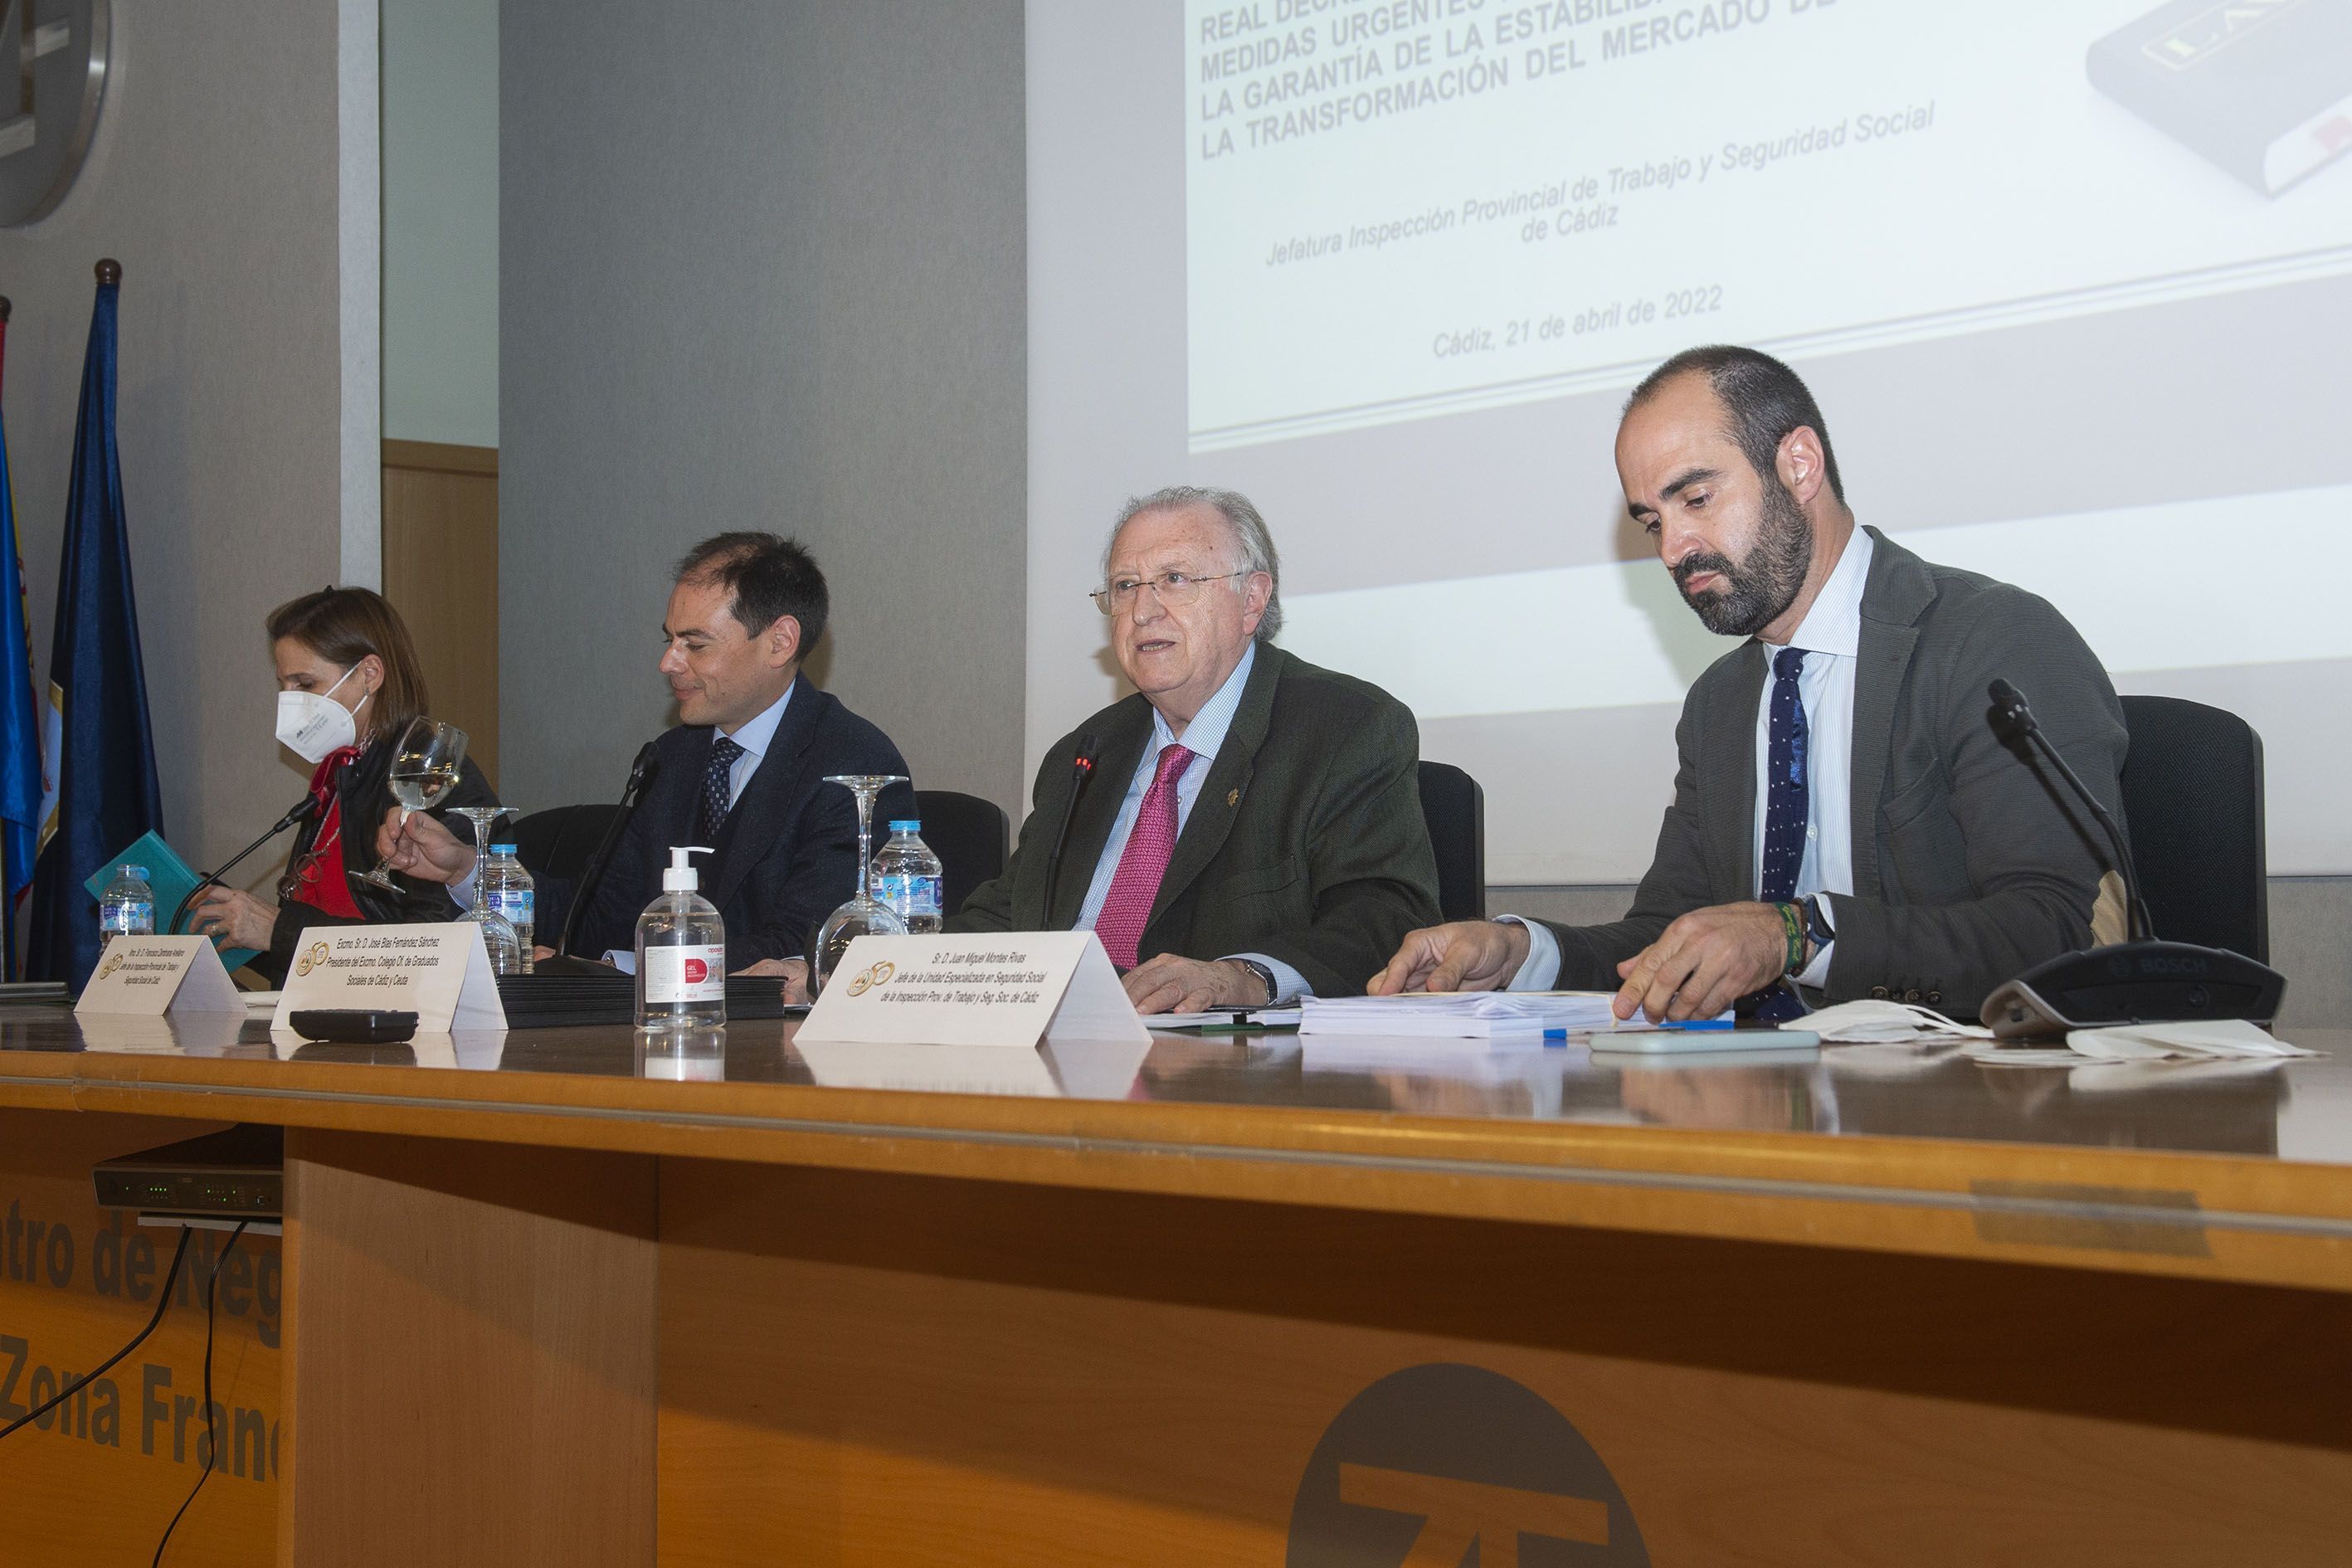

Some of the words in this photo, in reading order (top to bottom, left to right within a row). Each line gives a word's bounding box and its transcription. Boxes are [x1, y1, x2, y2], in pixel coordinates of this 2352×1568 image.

[1201, 1, 1268, 45] REAL
[1200, 26, 1317, 83] MEDIDAS
[1201, 88, 1235, 121] LA
[1244, 46, 1384, 110] GARANTÍA
[1395, 34, 1433, 71] DE
[1446, 22, 1484, 58] LA
[1201, 128, 1235, 160] LA
[1245, 56, 1509, 149] TRANSFORMACIÓN
[1526, 41, 1586, 80] DEL
[1602, 0, 1770, 61] MERCADO
[1266, 227, 1342, 267] Jefatura
[1349, 204, 1455, 251] Inspección
[1463, 178, 1566, 226] Provincial
[1571, 175, 1599, 202] de
[1607, 153, 1692, 195] Trabajo
[1697, 153, 1712, 183] y
[1721, 119, 1848, 171] Seguridad
[1854, 100, 1935, 144] Social
[1521, 216, 1548, 244] de
[1556, 202, 1619, 238] Cádiz
[1433, 327, 1497, 360] Cádiz,
[1506, 317, 1531, 345] 21
[1539, 309, 1565, 340] de
[1571, 299, 1620, 335] abril
[1627, 295, 1656, 326] de
[1663, 284, 1724, 318] 2022
[326, 957, 352, 967] Presidente
[351, 956, 361, 967] del
[377, 956, 397, 969] Colegio
[404, 955, 412, 967] de
[411, 955, 440, 967] Graduados
[368, 937, 382, 948] José
[381, 937, 392, 948] Blas
[392, 937, 418, 948] Fernández
[418, 936, 440, 947] Sánchez
[949, 952, 966, 963] Juan
[965, 952, 986, 966] Miguel
[986, 952, 1008, 963] Montes
[1008, 952, 1026, 963] Rivas
[347, 974, 368, 986] Sociales
[367, 974, 375, 986] de
[374, 974, 390, 986] Cádiz
[393, 974, 409, 985] Ceuta
[894, 971, 909, 983] Jefe
[908, 971, 917, 983] de
[923, 971, 946, 983] Unidad
[943, 971, 986, 986] Especializada
[985, 974, 995, 983] en
[994, 971, 1028, 986] Seguridad
[1025, 971, 1048, 983] Social
[2140, 957, 2207, 972] BOSCH
[880, 991, 890, 1002] de
[896, 991, 929, 1004] Inspección
[927, 991, 942, 1002] Prov.
[942, 991, 952, 1002] de
[952, 991, 976, 1006] Trabajo
[980, 991, 995, 1006] Seg.
[995, 991, 1010, 1002] Soc.
[1010, 991, 1020, 1002] de
[1020, 991, 1040, 1002] Cádiz
[0, 1197, 75, 1289] tro
[0, 1335, 120, 1449] Zona
